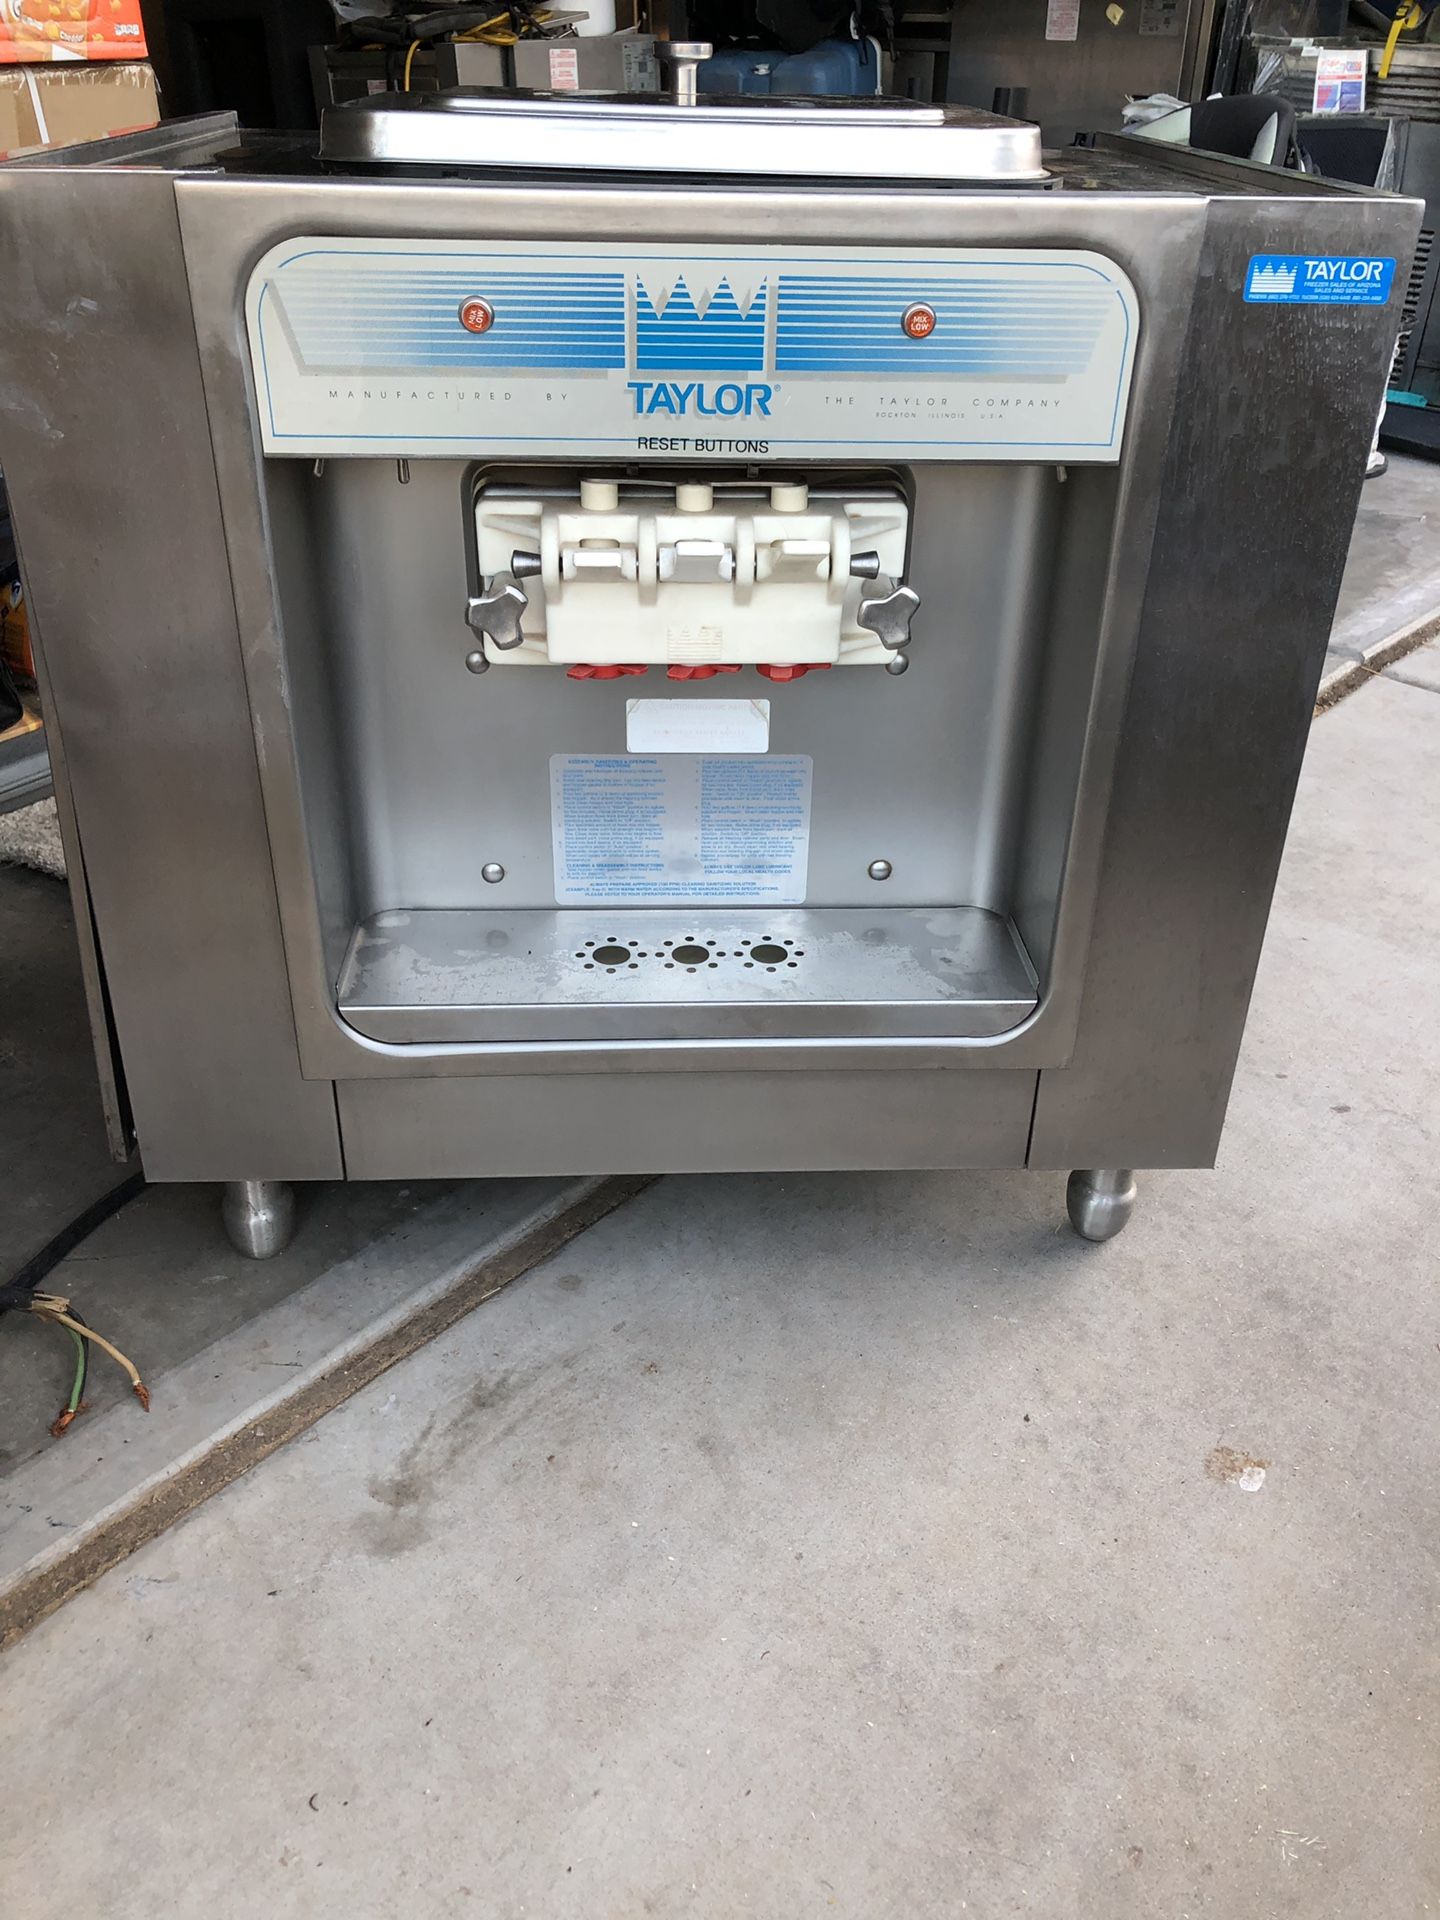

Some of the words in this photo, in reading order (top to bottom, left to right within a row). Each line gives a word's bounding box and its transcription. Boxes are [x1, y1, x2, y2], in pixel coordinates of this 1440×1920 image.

[1304, 260, 1384, 281] TAYLOR
[911, 323, 929, 331] LOW
[329, 390, 511, 400] MANUFACTURED
[627, 382, 772, 416] TAYLOR
[825, 396, 855, 405] THE
[880, 397, 948, 406] TAYLOR
[973, 398, 1060, 407] COMPANY
[637, 437, 690, 451] RESET
[695, 440, 769, 454] BUTTONS
